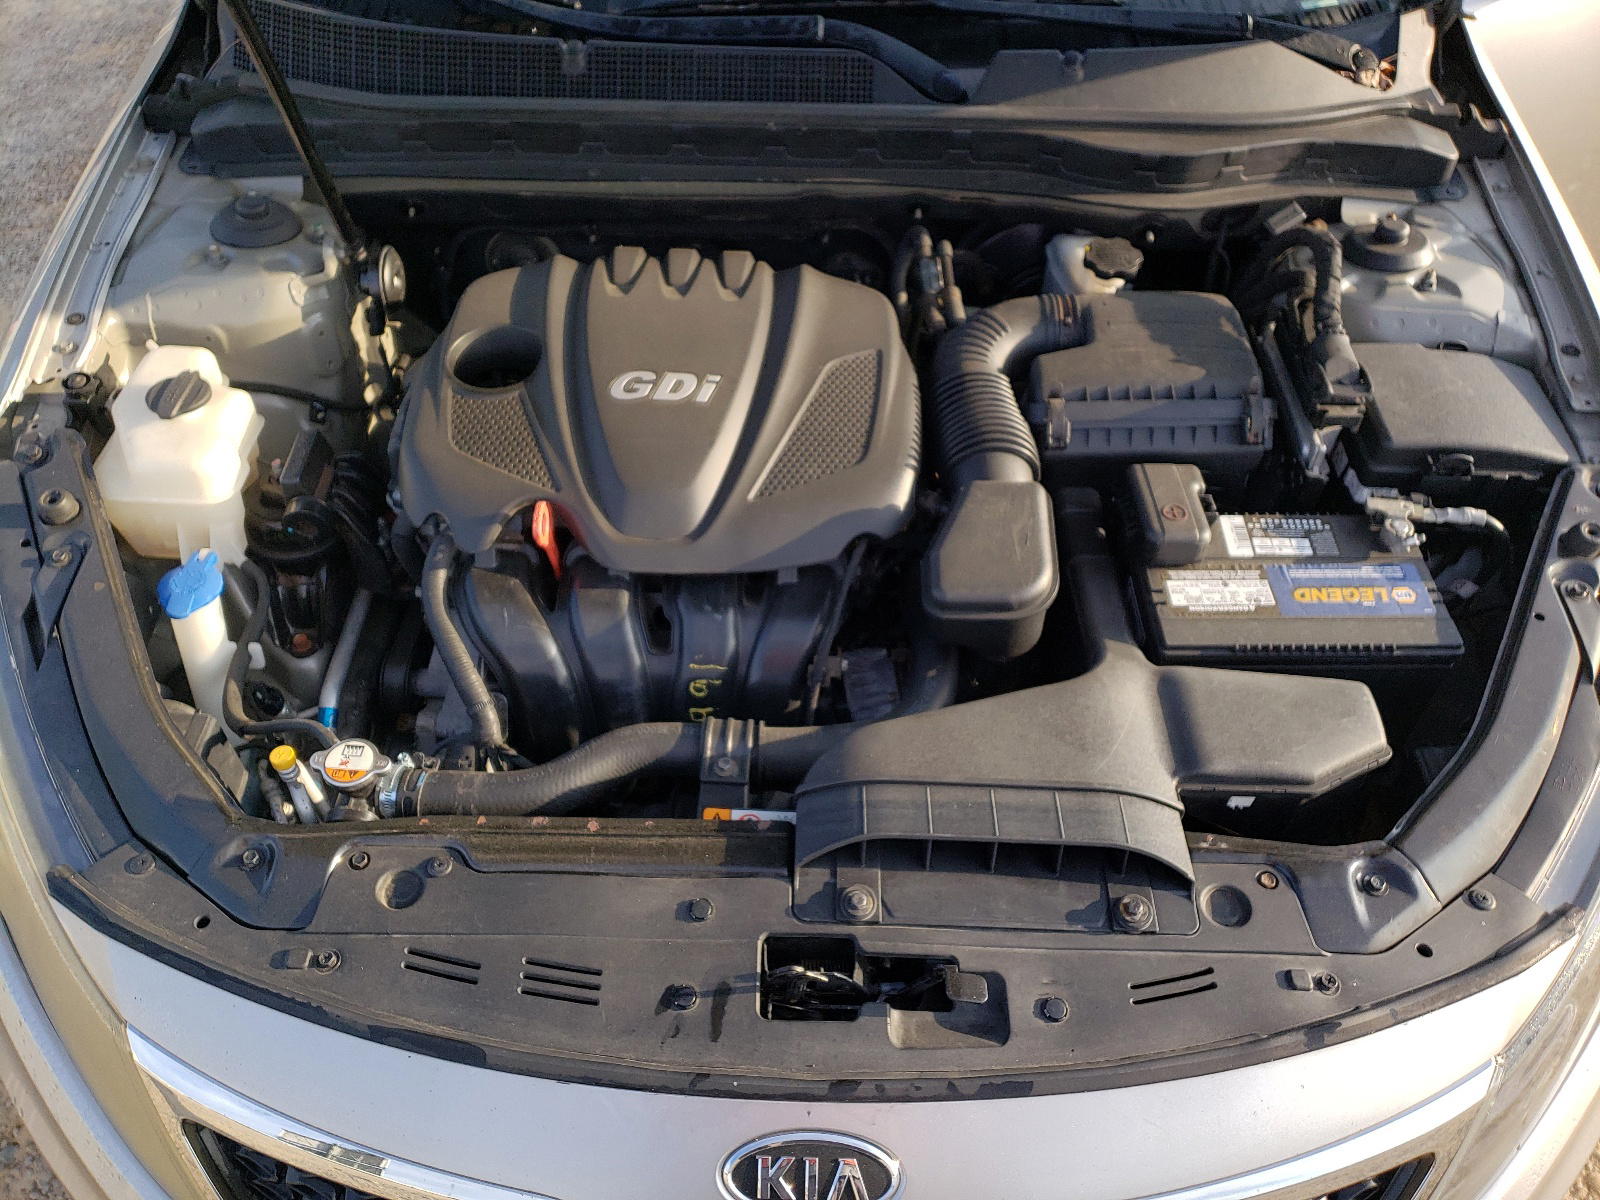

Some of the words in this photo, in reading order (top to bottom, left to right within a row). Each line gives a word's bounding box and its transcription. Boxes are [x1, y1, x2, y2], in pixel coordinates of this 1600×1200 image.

[609, 370, 722, 403] GDi
[1292, 586, 1390, 604] LEGEND
[755, 1154, 870, 1200] KIA
